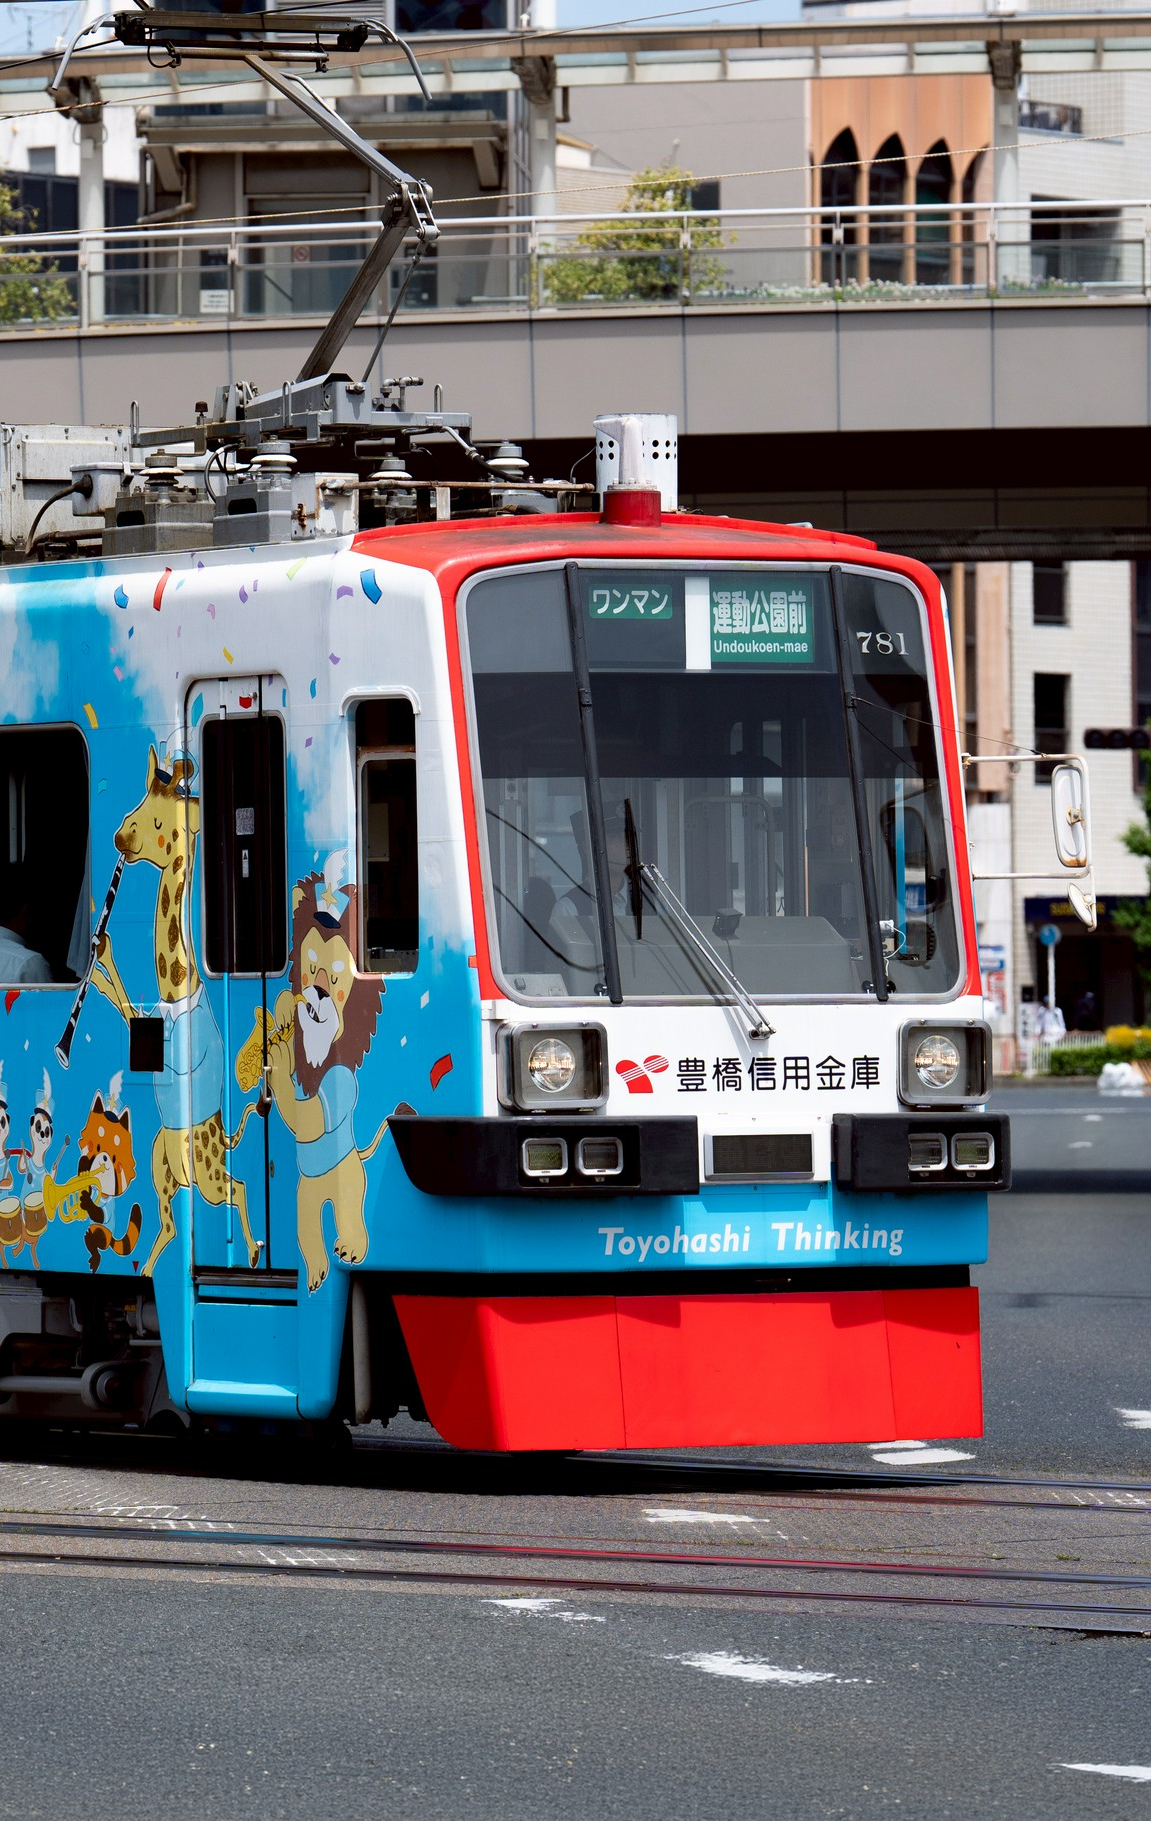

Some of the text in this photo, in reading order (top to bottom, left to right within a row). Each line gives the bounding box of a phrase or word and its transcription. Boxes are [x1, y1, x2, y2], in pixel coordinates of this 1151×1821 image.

[592, 589, 669, 615] ワンマン
[712, 590, 808, 635] 運動公園前
[713, 638, 809, 654] Undoukoen-mae
[856, 631, 910, 656] 781
[676, 1054, 881, 1093] 豊橋信用金庫
[597, 1221, 905, 1263] Toyohashi Thinking
